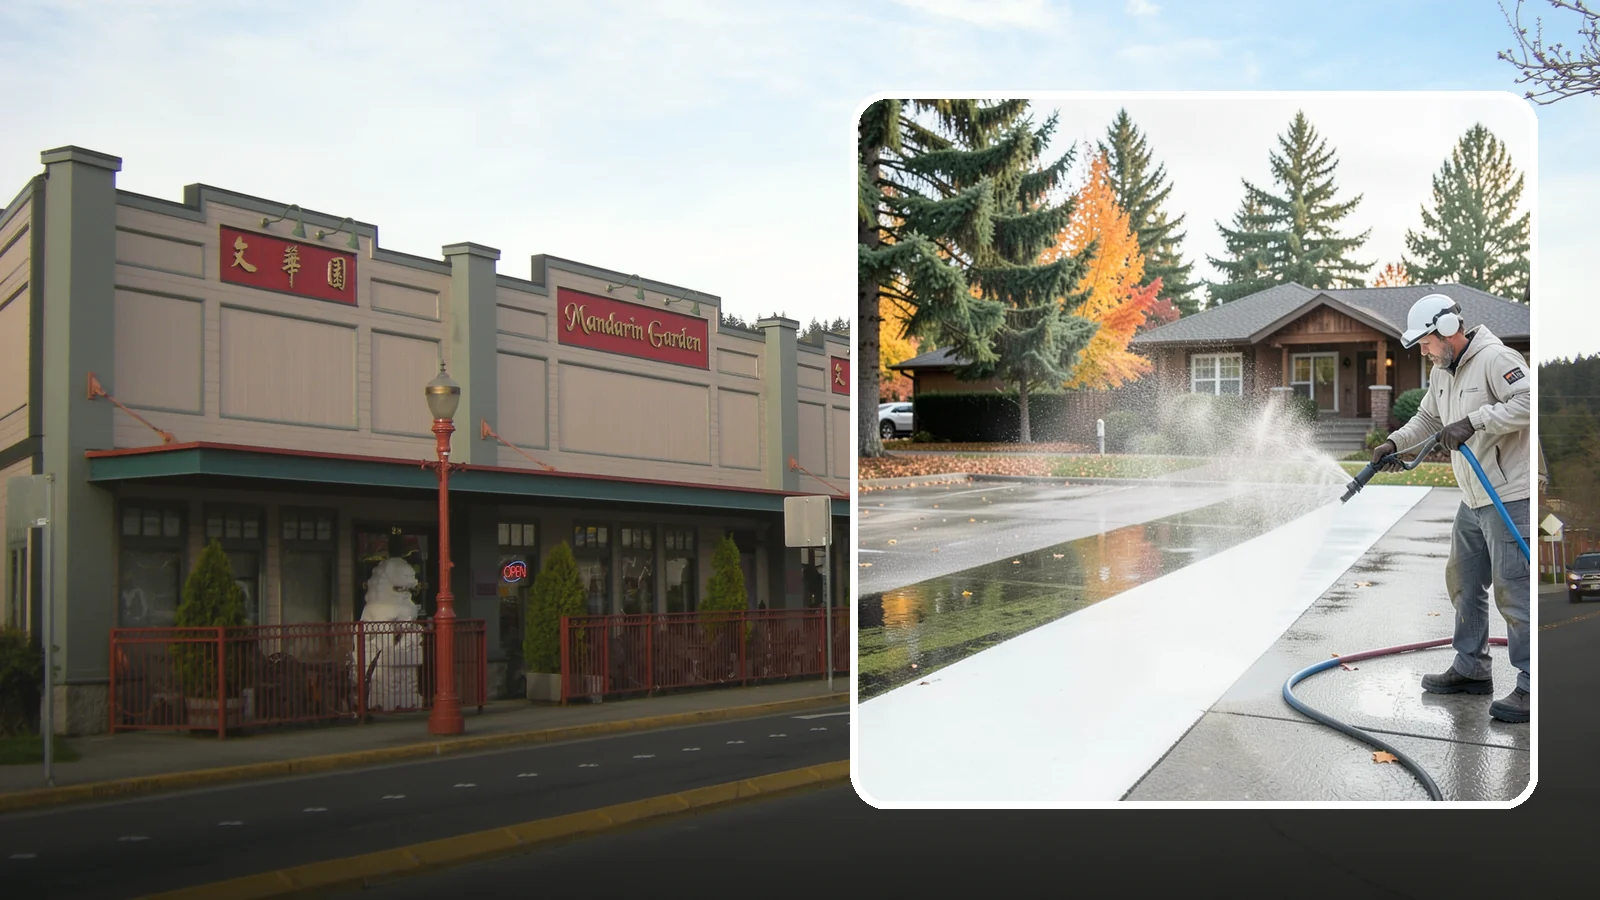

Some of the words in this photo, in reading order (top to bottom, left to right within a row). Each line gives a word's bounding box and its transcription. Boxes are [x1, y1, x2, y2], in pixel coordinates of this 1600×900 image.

[231, 235, 346, 291] 文華園
[564, 302, 644, 341] Mandarin
[648, 320, 701, 352] Garden
[503, 565, 527, 578] OPEN
